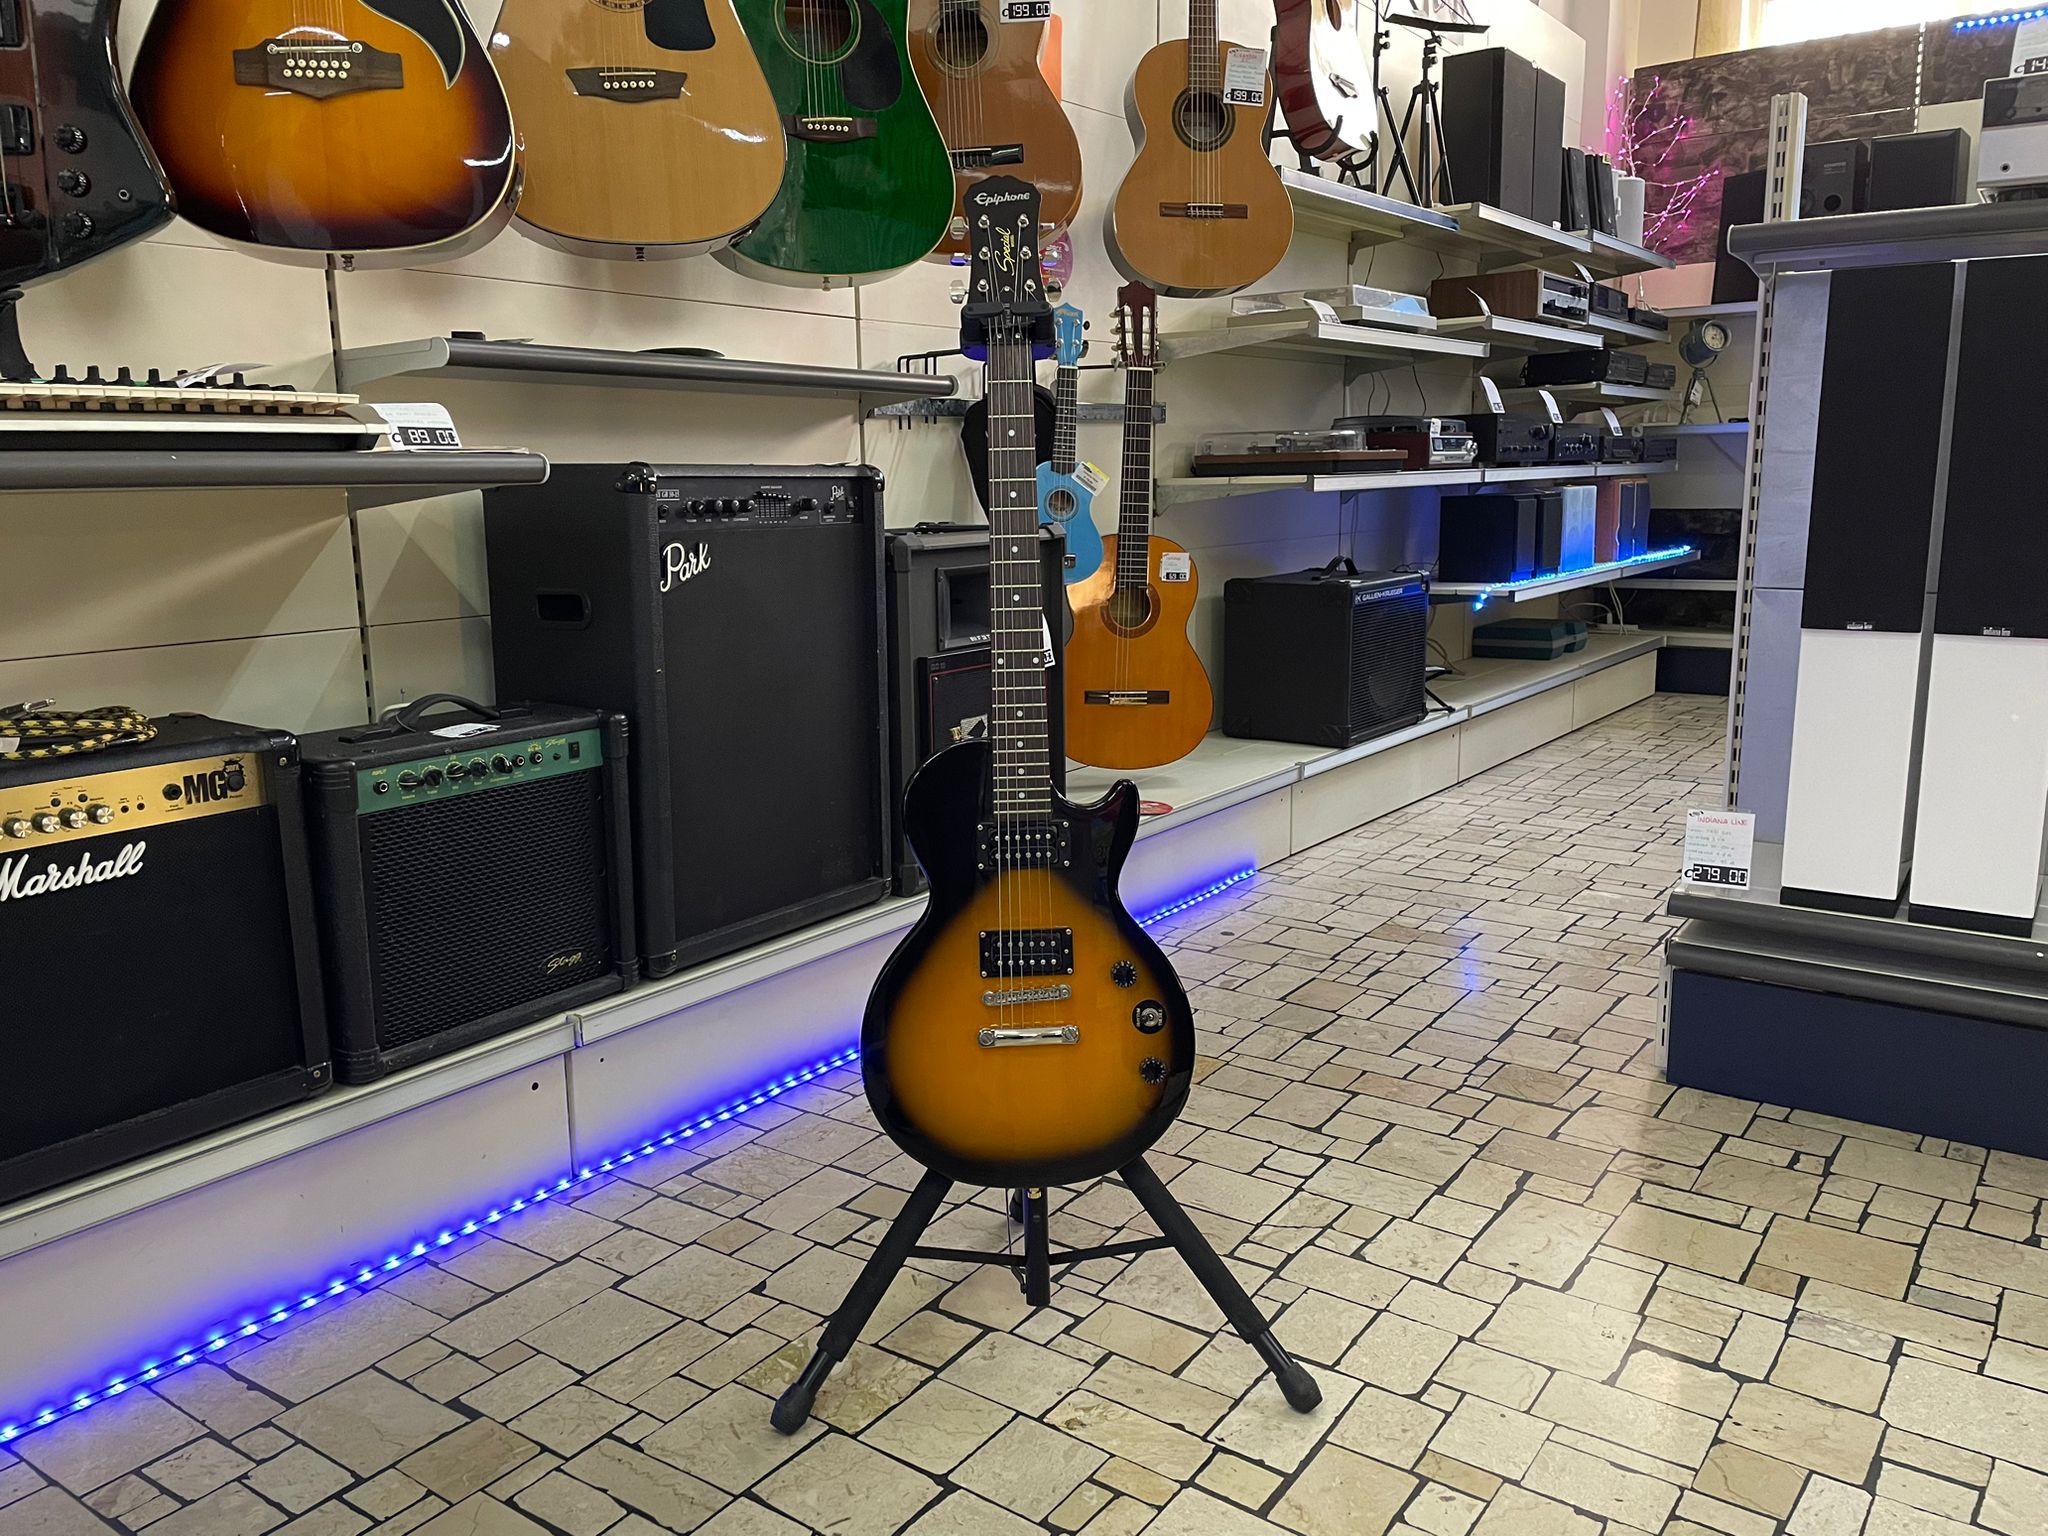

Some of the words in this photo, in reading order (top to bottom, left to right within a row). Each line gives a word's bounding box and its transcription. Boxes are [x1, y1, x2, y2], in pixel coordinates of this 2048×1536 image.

[974, 192, 1031, 206] Epiphone
[995, 226, 1015, 276] Special
[831, 485, 845, 500] Park
[660, 542, 712, 592] Park
[183, 770, 228, 804] MG
[0, 841, 146, 901] Marshall
